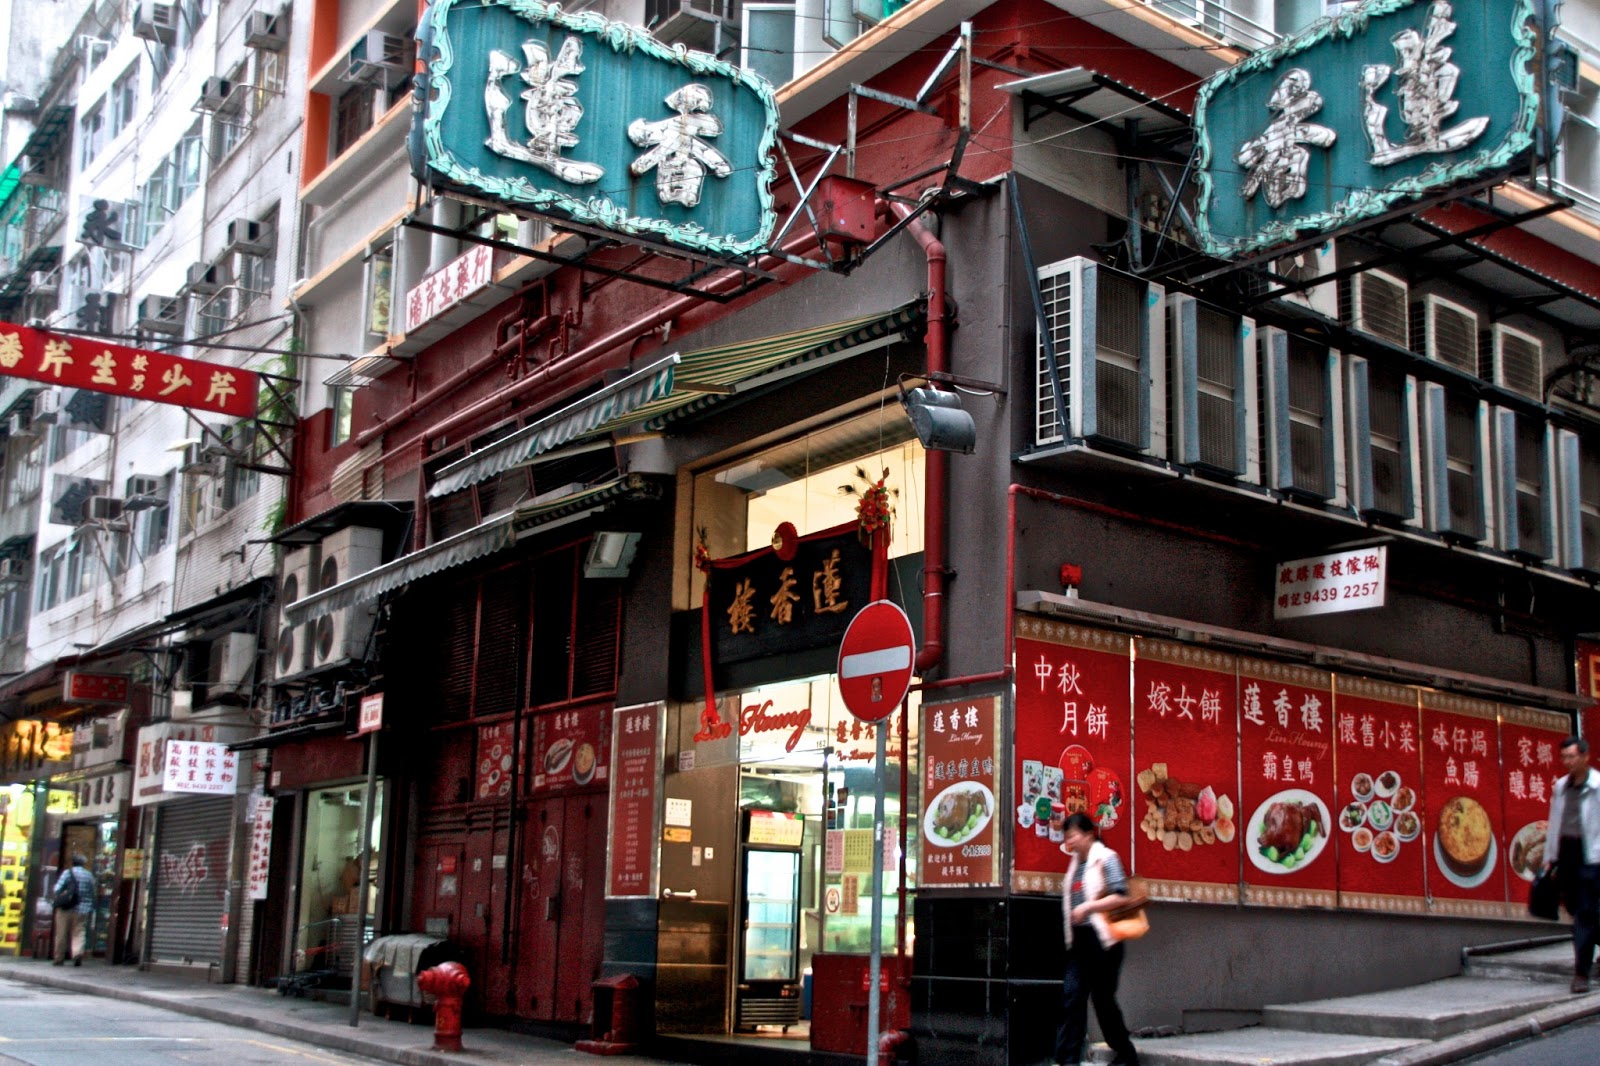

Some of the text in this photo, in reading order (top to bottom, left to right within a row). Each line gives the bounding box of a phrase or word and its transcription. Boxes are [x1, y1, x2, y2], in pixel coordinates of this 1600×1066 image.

[485, 36, 734, 208] 蓮香
[1343, 582, 1379, 598] 2257
[1034, 655, 1083, 695] 中秋
[933, 706, 979, 733] 蓮香樓
[1060, 702, 1109, 739] 月餅
[1147, 681, 1222, 724] 嫁女餅
[1243, 682, 1324, 733] 蓮香樓
[1338, 713, 1416, 752] 懷舊小菜
[1262, 752, 1314, 784] 霸皇鴨
[1444, 756, 1480, 788] 魚腸
[1509, 769, 1557, 803] 釀鯪
